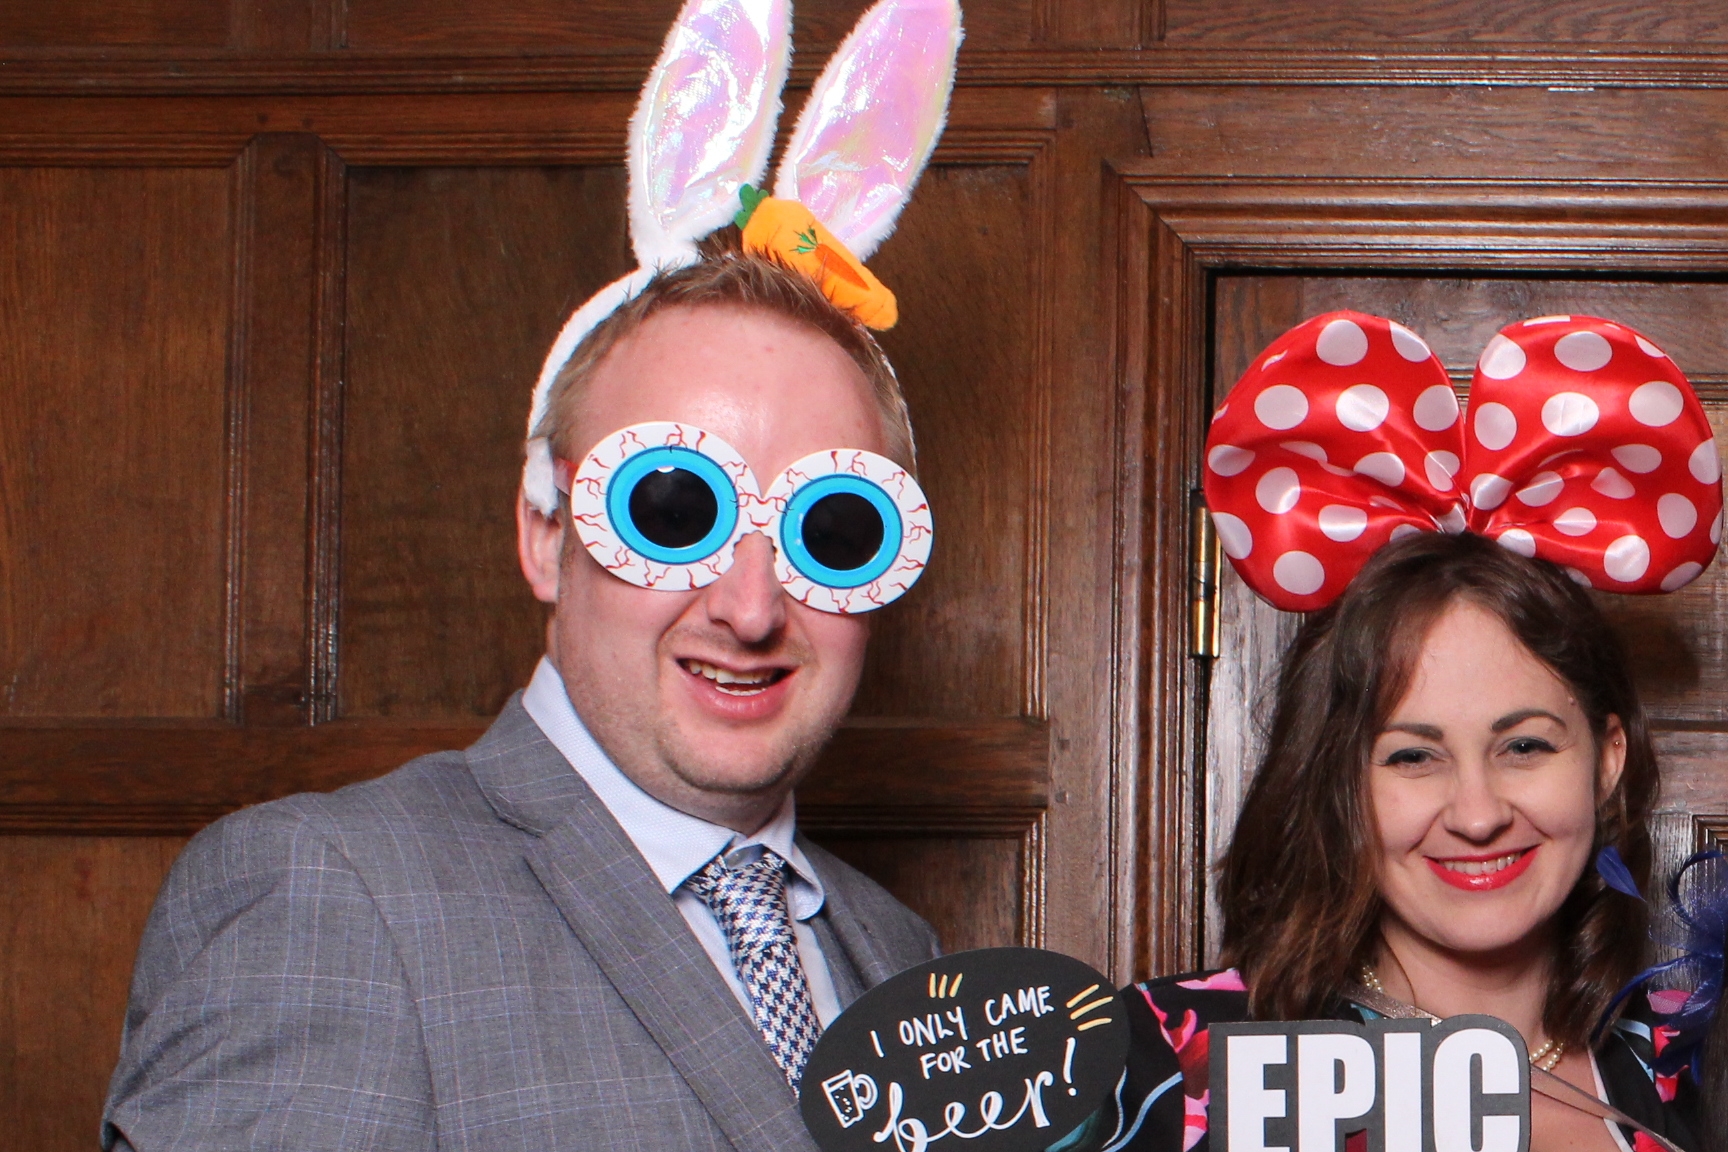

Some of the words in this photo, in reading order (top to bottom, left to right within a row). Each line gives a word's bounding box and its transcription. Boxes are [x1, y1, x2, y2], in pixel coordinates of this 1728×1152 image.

[870, 1030, 885, 1058] I
[899, 1006, 969, 1047] ONLY
[985, 986, 1054, 1026] CAME
[920, 1046, 971, 1080] FOR
[976, 1027, 1028, 1061] THE
